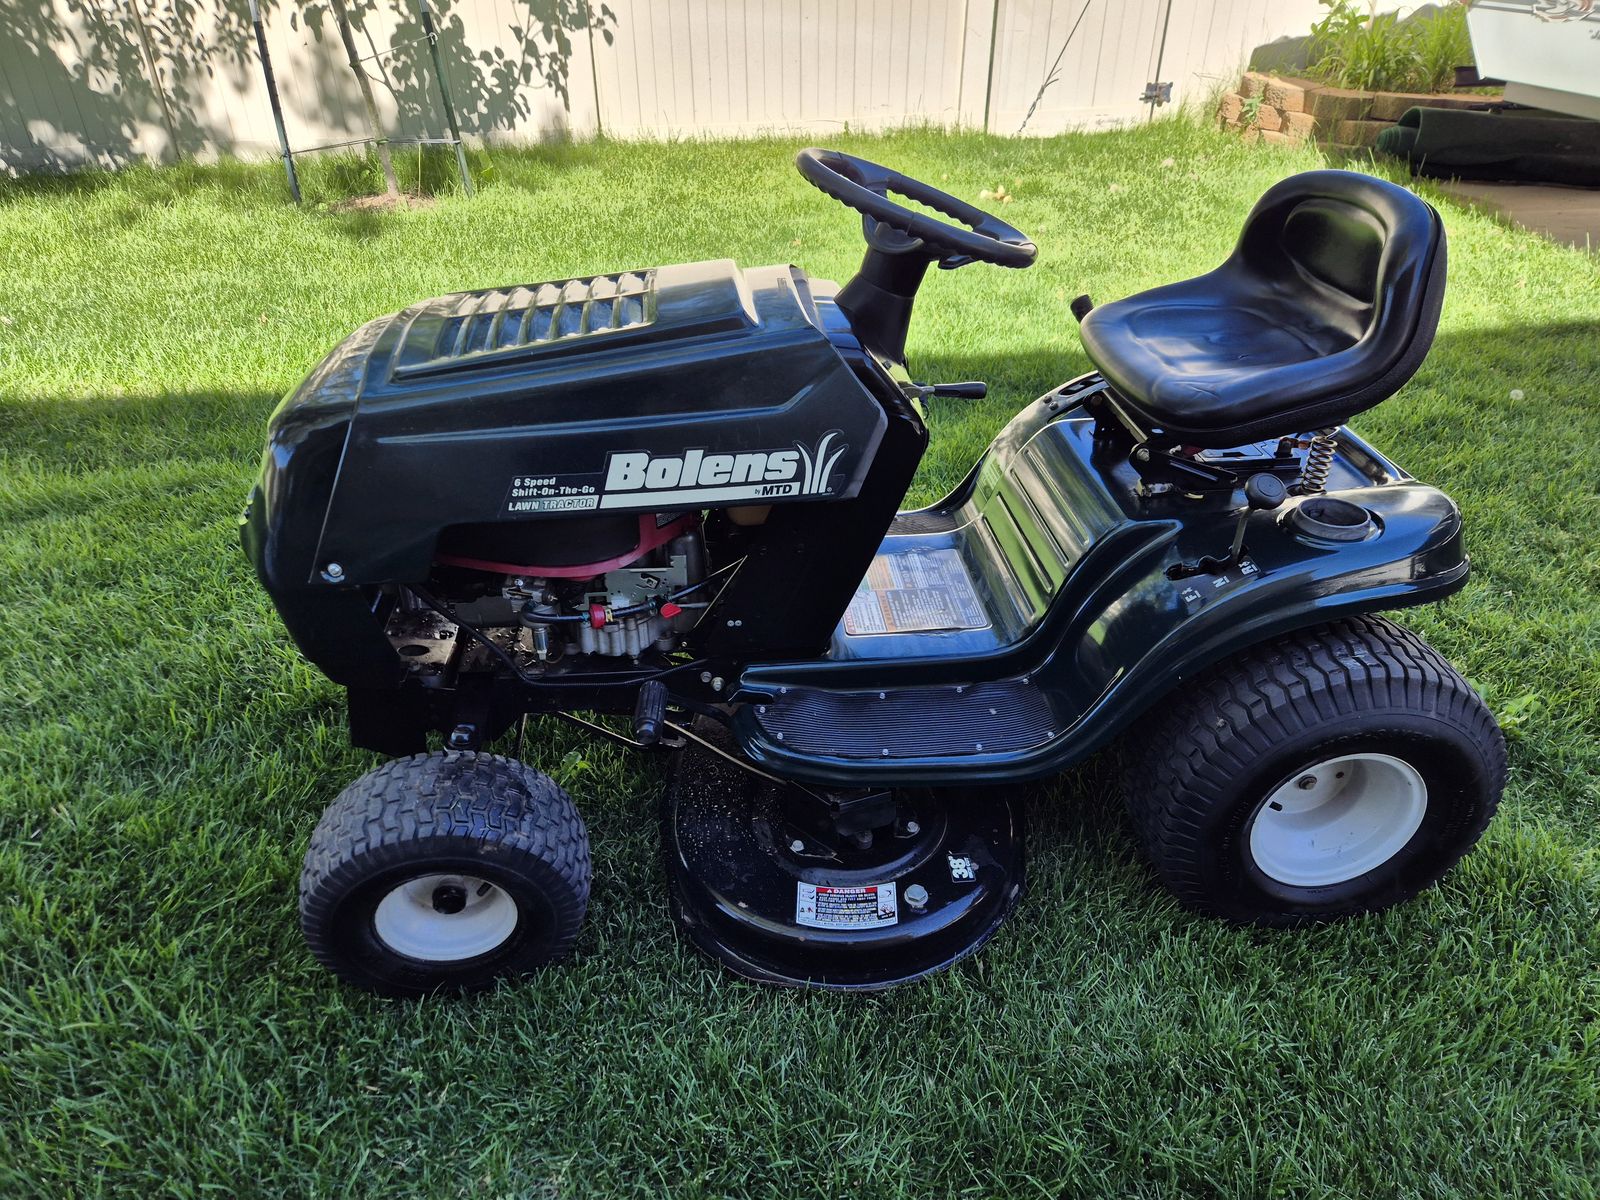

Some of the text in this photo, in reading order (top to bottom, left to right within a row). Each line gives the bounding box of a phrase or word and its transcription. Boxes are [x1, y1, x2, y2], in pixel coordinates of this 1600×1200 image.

[604, 449, 800, 491] Bolens
[514, 477, 556, 487] 6 Speed
[511, 485, 595, 497] Shift-On-The-Go
[762, 484, 793, 496] MTD
[508, 498, 595, 511] LAWN TRACTOR
